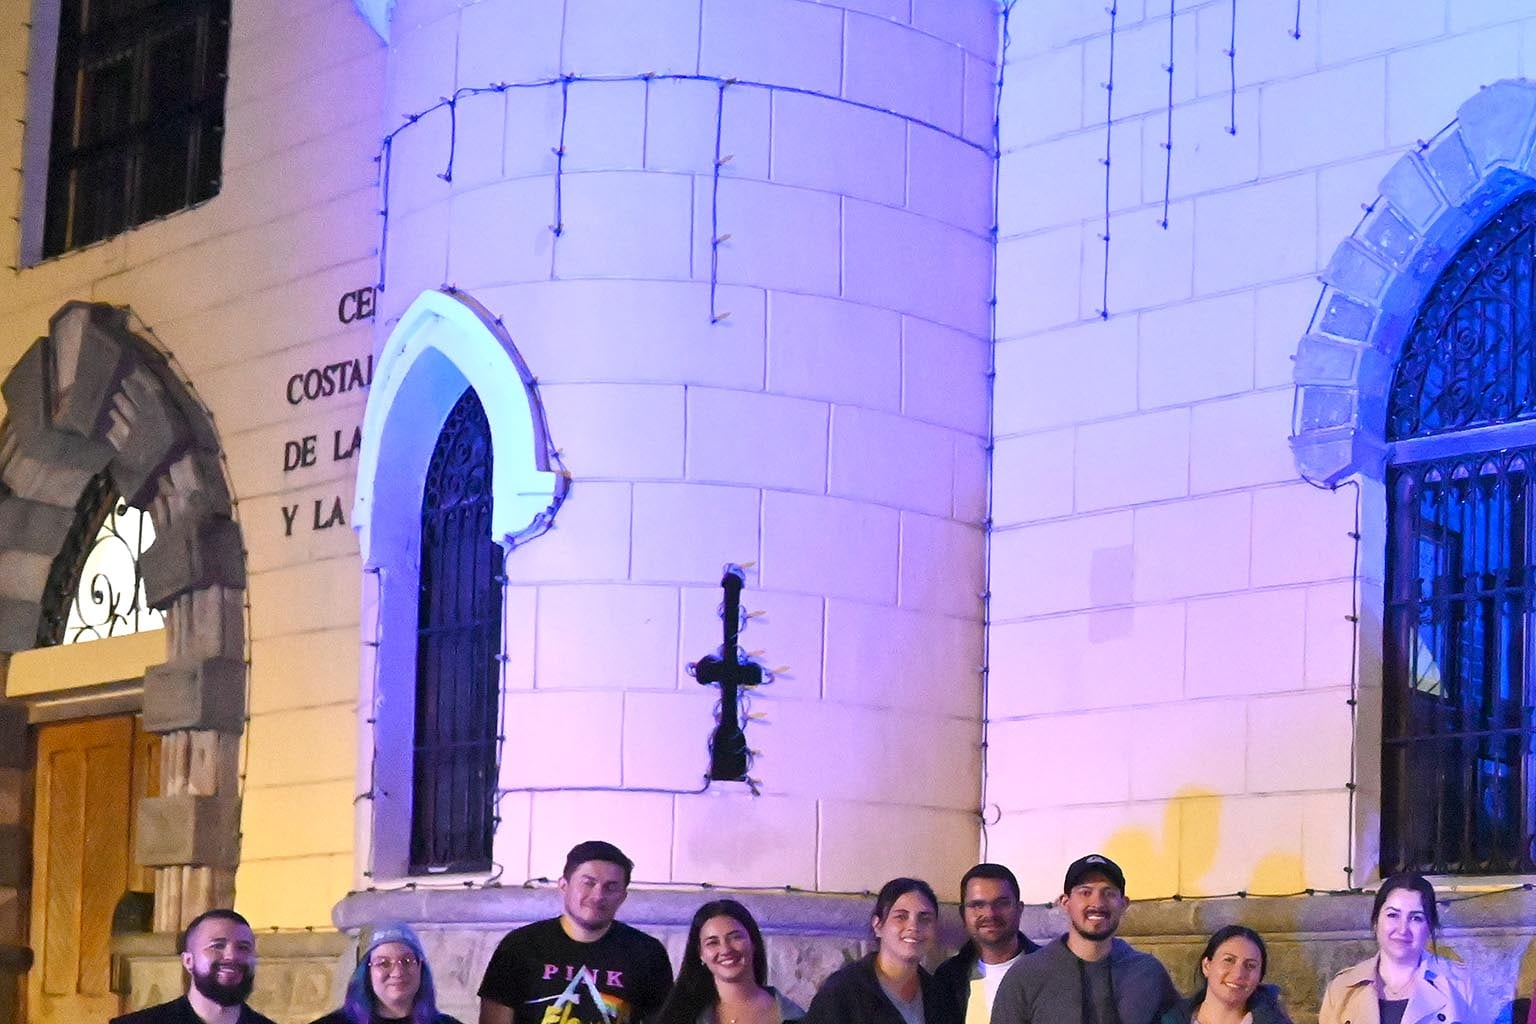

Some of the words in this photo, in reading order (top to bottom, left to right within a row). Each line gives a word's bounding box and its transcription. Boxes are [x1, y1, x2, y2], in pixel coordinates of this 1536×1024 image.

[338, 286, 375, 324] CE
[283, 435, 317, 471] DE
[281, 504, 298, 536] Y
[313, 495, 345, 530] LA
[542, 963, 624, 988] PINK
